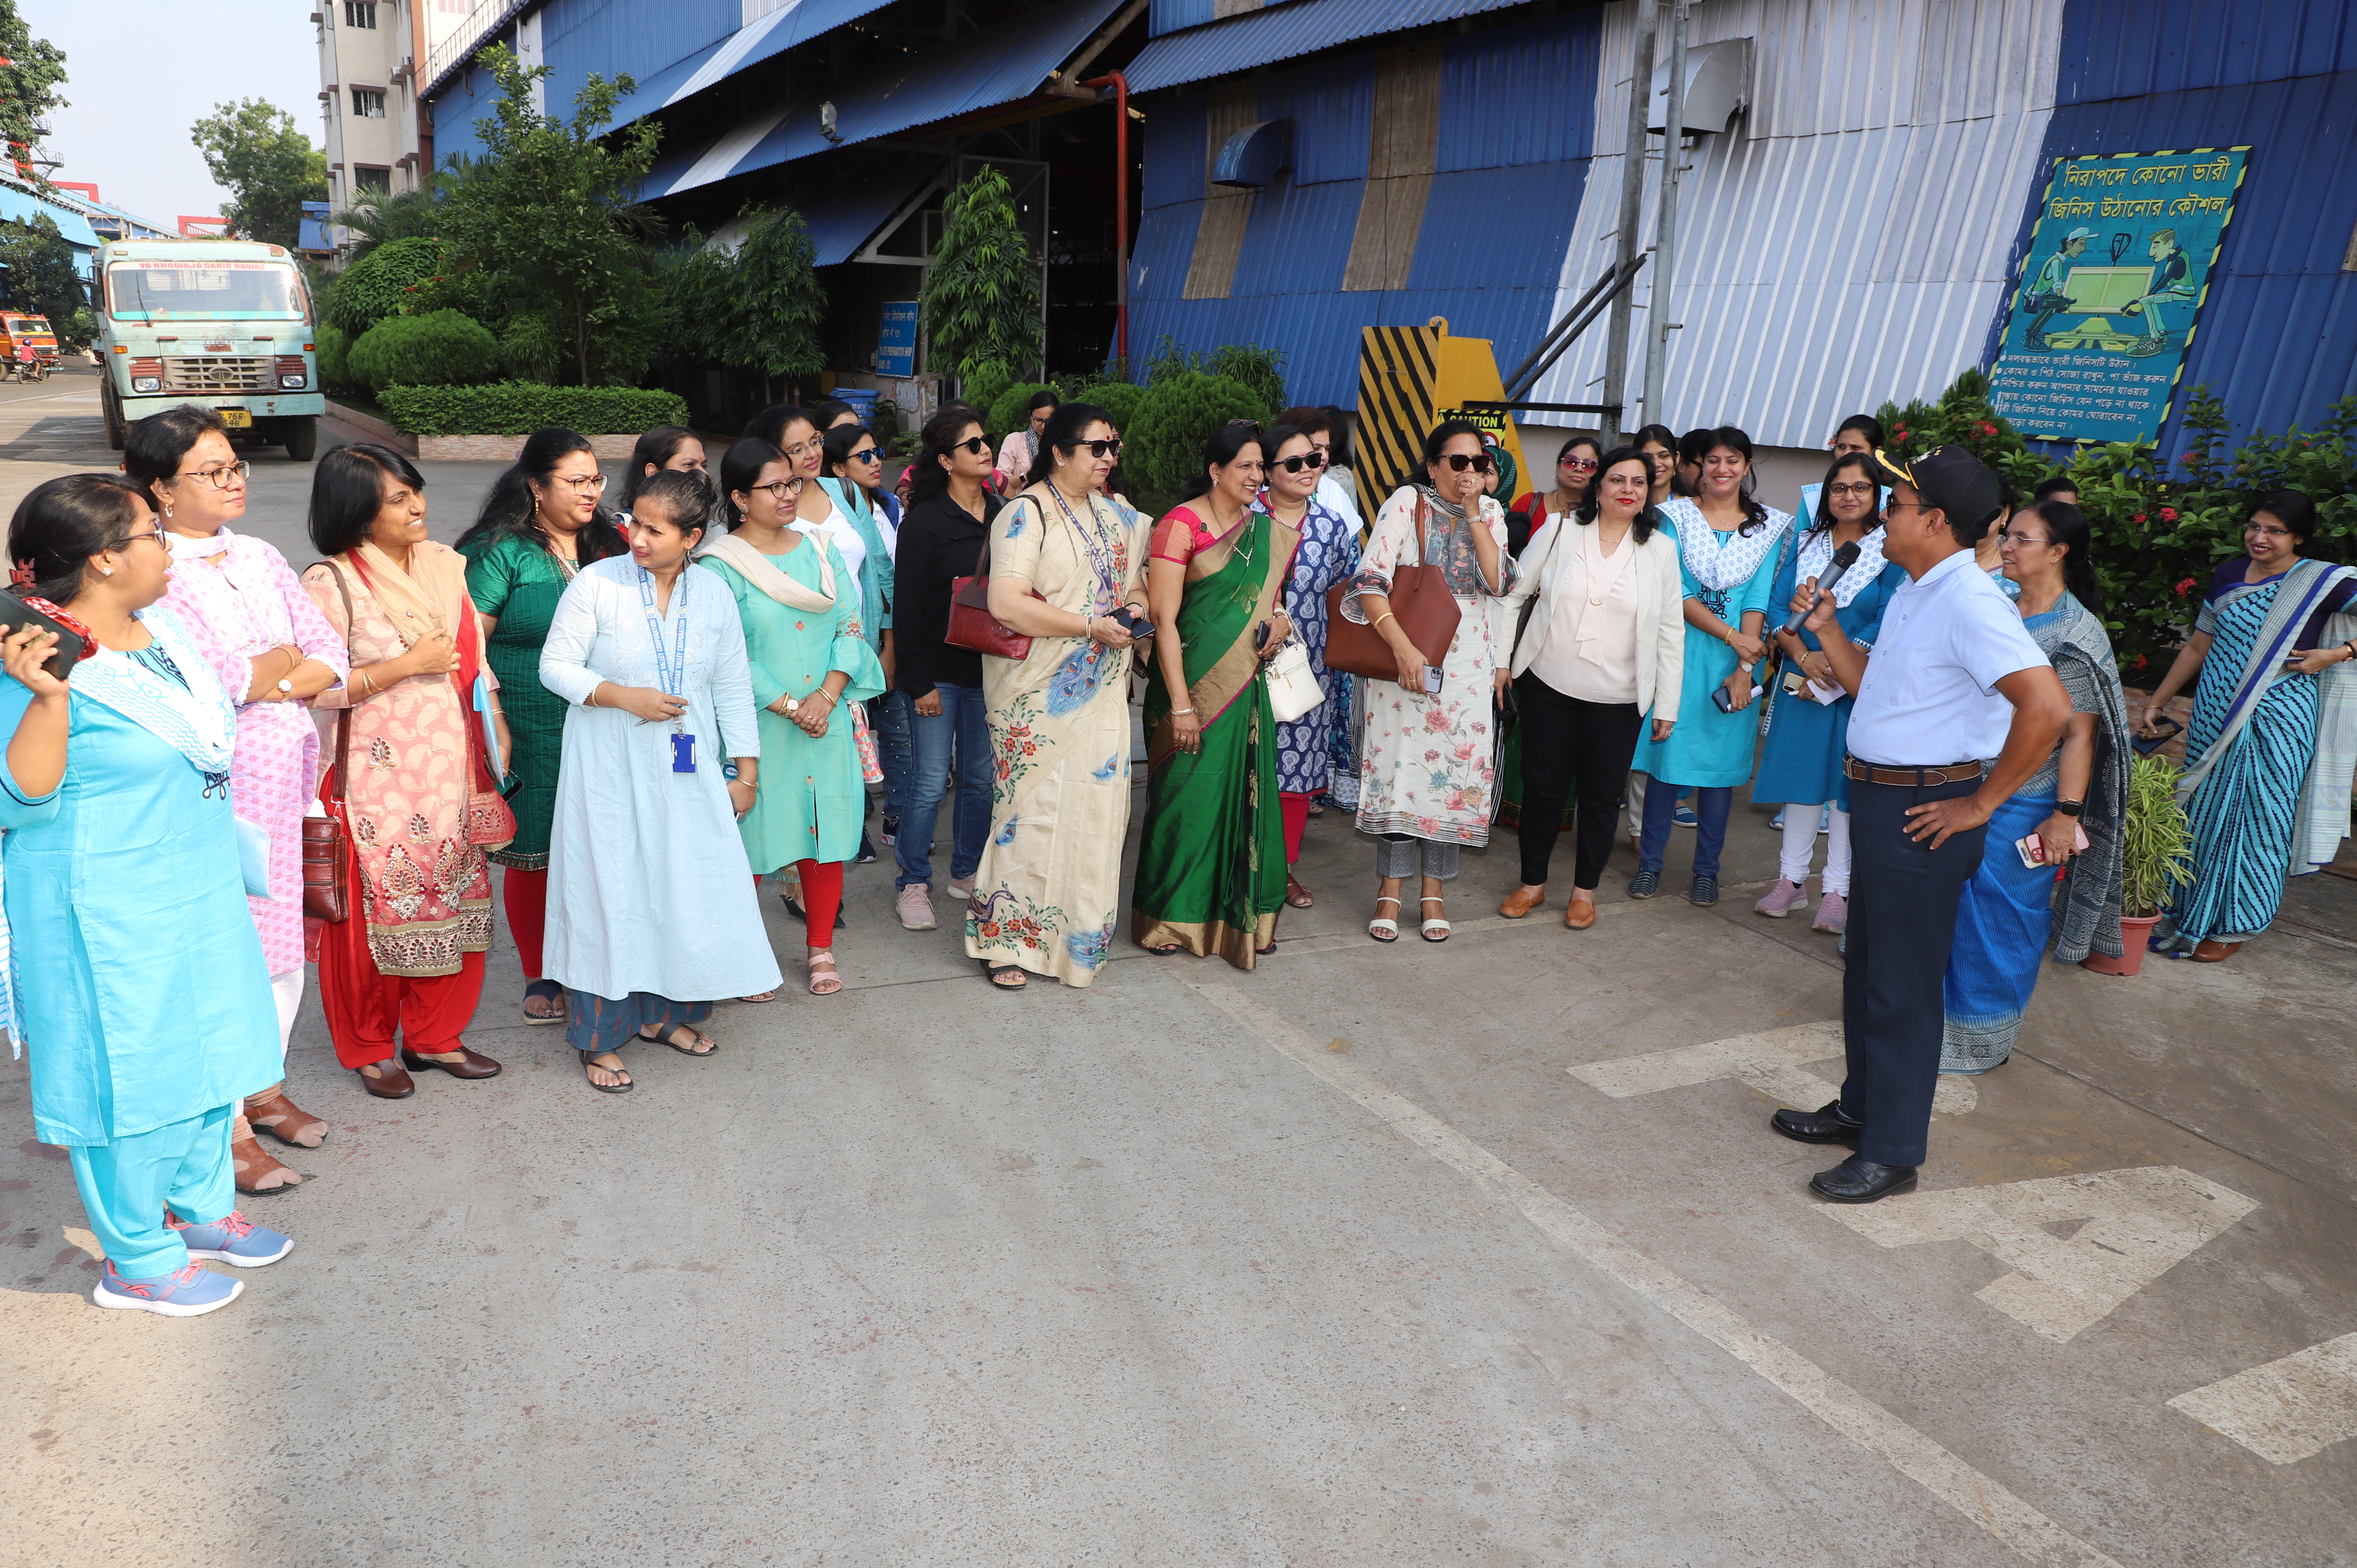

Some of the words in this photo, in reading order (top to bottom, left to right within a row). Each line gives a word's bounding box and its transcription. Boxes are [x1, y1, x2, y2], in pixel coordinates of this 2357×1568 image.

[2063, 164, 2129, 189] নিরাপদে
[2132, 163, 2188, 186] কোনো
[2192, 155, 2231, 182] ভারী
[2048, 197, 2096, 220] জিনিস
[2100, 193, 2165, 219] উঠানোর
[2168, 191, 2228, 218] কৌশল
[2008, 355, 2050, 364] দলবদ্ধভাবে
[2053, 355, 2070, 365] ভারী
[2072, 355, 2106, 367] জিনিসটি
[2108, 356, 2130, 368] উঠান
[2003, 368, 2028, 376] কোমর
[2040, 367, 2054, 377] পিঠ
[2056, 370, 2081, 379] সোজা
[2110, 373, 2120, 381] পা
[2122, 371, 2142, 382] ভাঁজ
[2143, 375, 2167, 384] করুন
[2000, 377, 2026, 388] নিশ্চিত
[2050, 382, 2081, 392] আপনার
[2083, 385, 2115, 394] সামনের
[2117, 387, 2149, 397] যাওয়ার
[2021, 393, 2047, 403] কোনো
[2049, 393, 2074, 404] জিনিস
[2076, 397, 2092, 406] যেন
[2095, 398, 2113, 408] পড়ে
[2115, 399, 2126, 408] না
[2128, 401, 2150, 410] থাকে
[2011, 403, 2036, 415] জিনিস
[2037, 406, 2056, 416] নিয়ে
[2058, 409, 2084, 418] কোমর
[2086, 411, 2124, 421] ঘোরাবেন
[2028, 419, 2055, 429] করবেন
[2057, 421, 2067, 431] না
[641, 581, 652, 605] DAMODAR
[649, 619, 663, 652] CORPORATION
[677, 619, 686, 651] CORPORATION
[657, 653, 667, 670] VALLEY
[661, 670, 671, 694] DAMODAR
